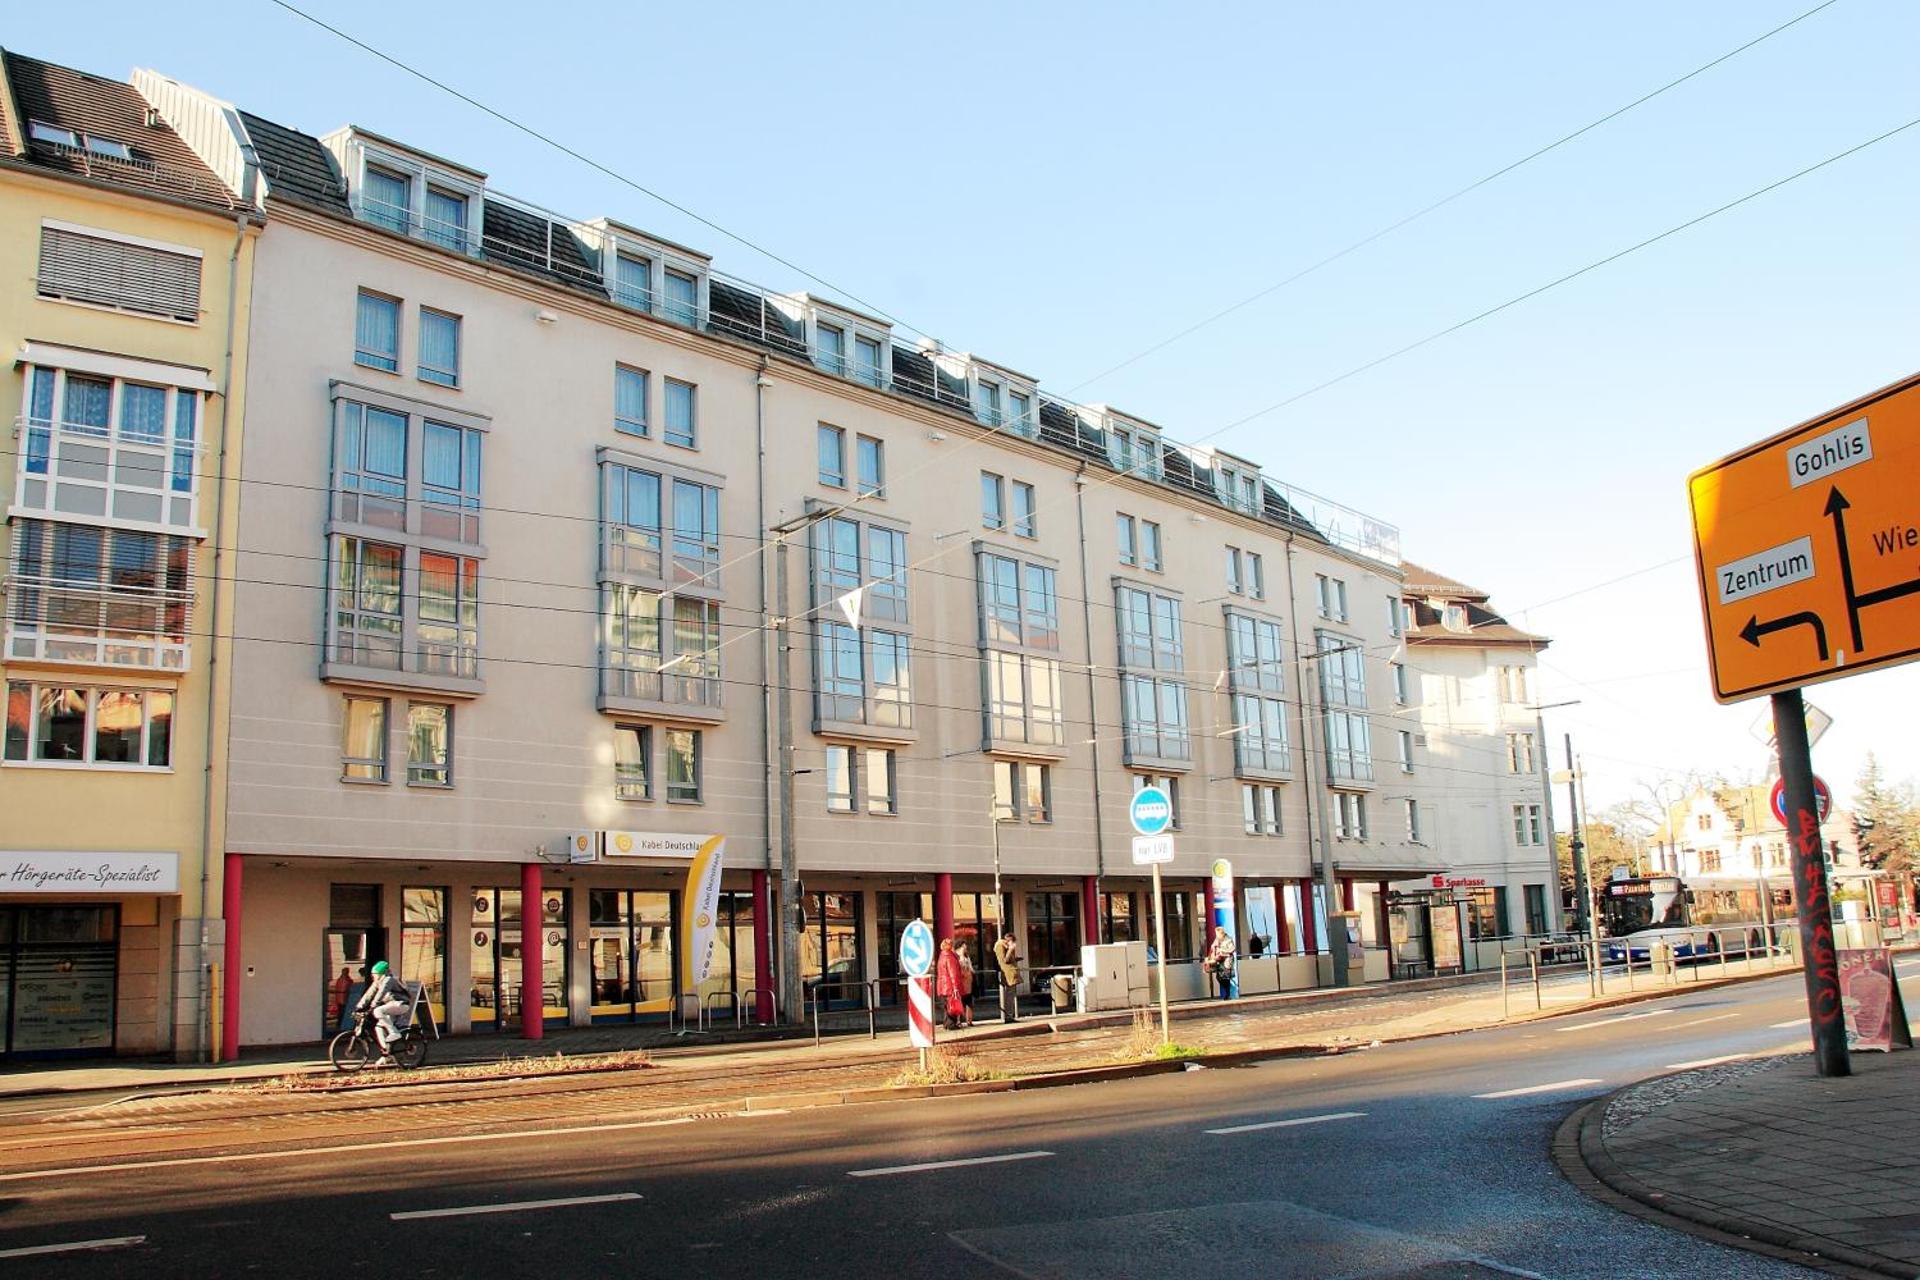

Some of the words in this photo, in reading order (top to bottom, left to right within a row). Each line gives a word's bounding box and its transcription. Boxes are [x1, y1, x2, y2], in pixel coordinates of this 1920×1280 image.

[1795, 435, 1864, 476] Gohlis
[1723, 554, 1808, 595] Zentrum
[10, 862, 161, 888] Hörgeräte-Spezialist
[1446, 878, 1485, 887] Sparkasse
